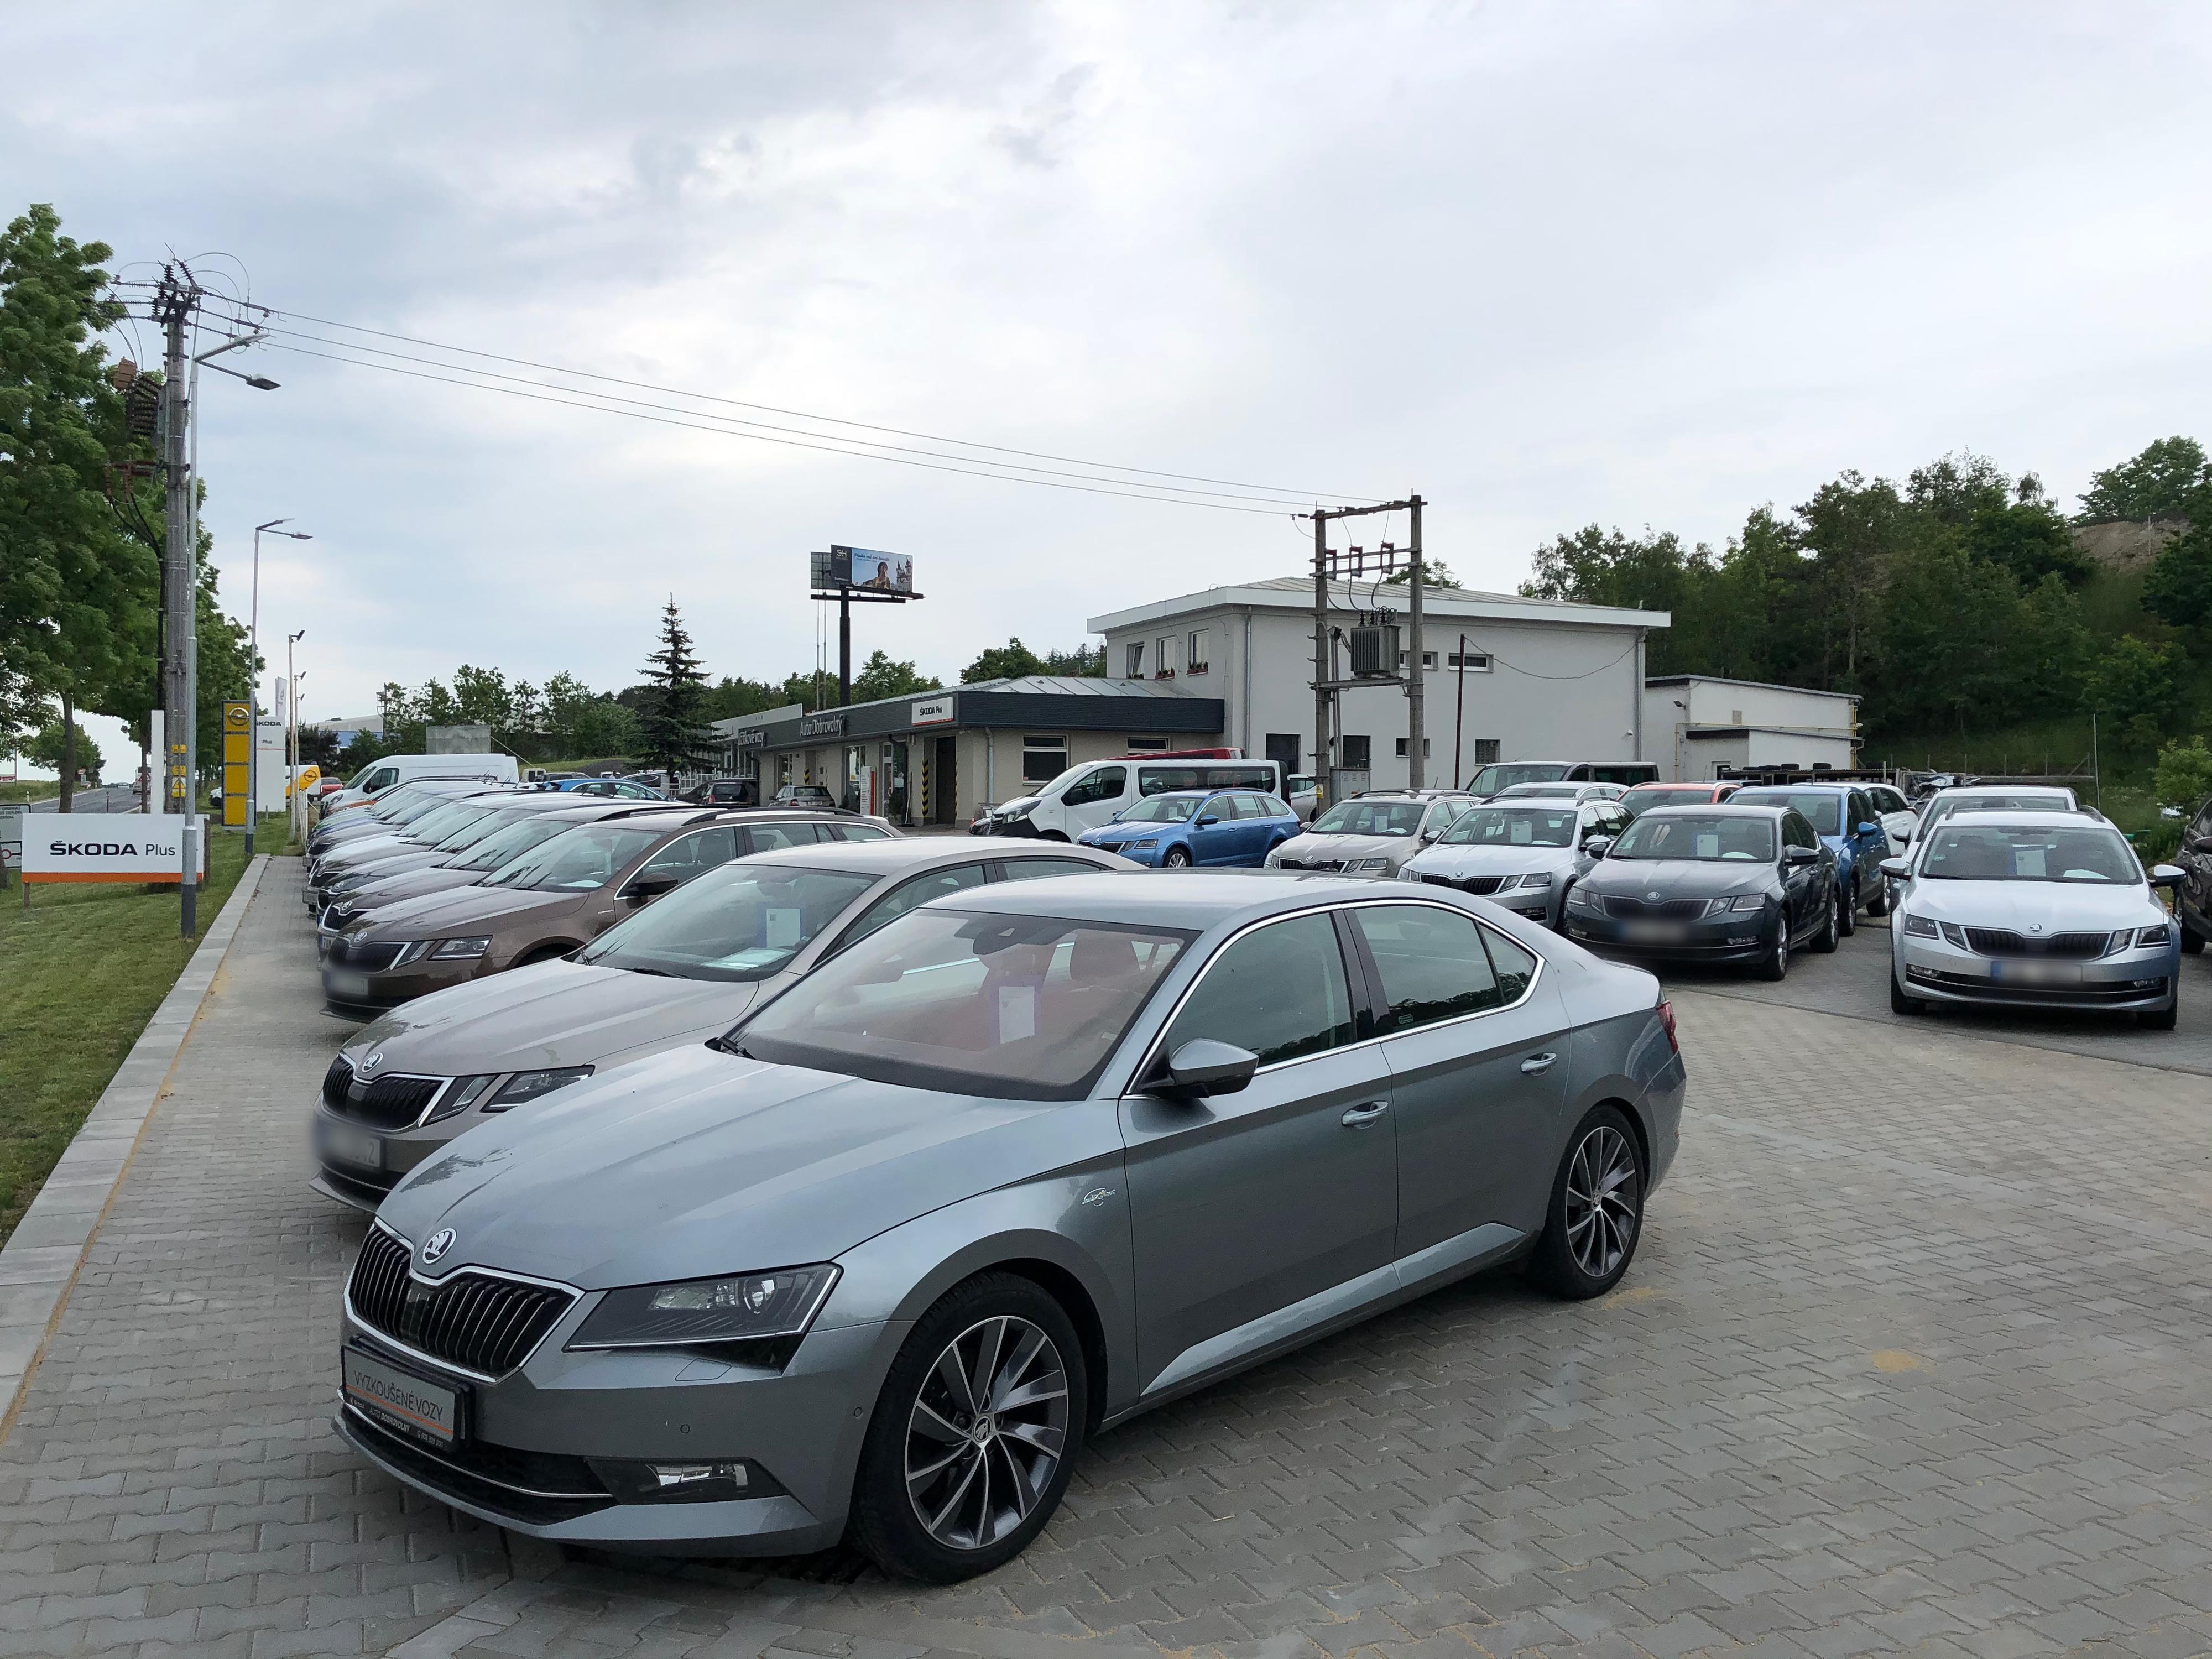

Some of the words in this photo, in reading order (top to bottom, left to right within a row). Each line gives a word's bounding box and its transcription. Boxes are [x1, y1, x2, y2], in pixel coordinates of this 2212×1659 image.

[920, 707, 935, 716] ŠKODA
[800, 721, 812, 737] Auto
[50, 840, 138, 856] ŠKODA
[145, 844, 175, 856] Plus
[354, 1371, 414, 1410] VYZKOUŠENÉ
[415, 1397, 444, 1421] VOZY
